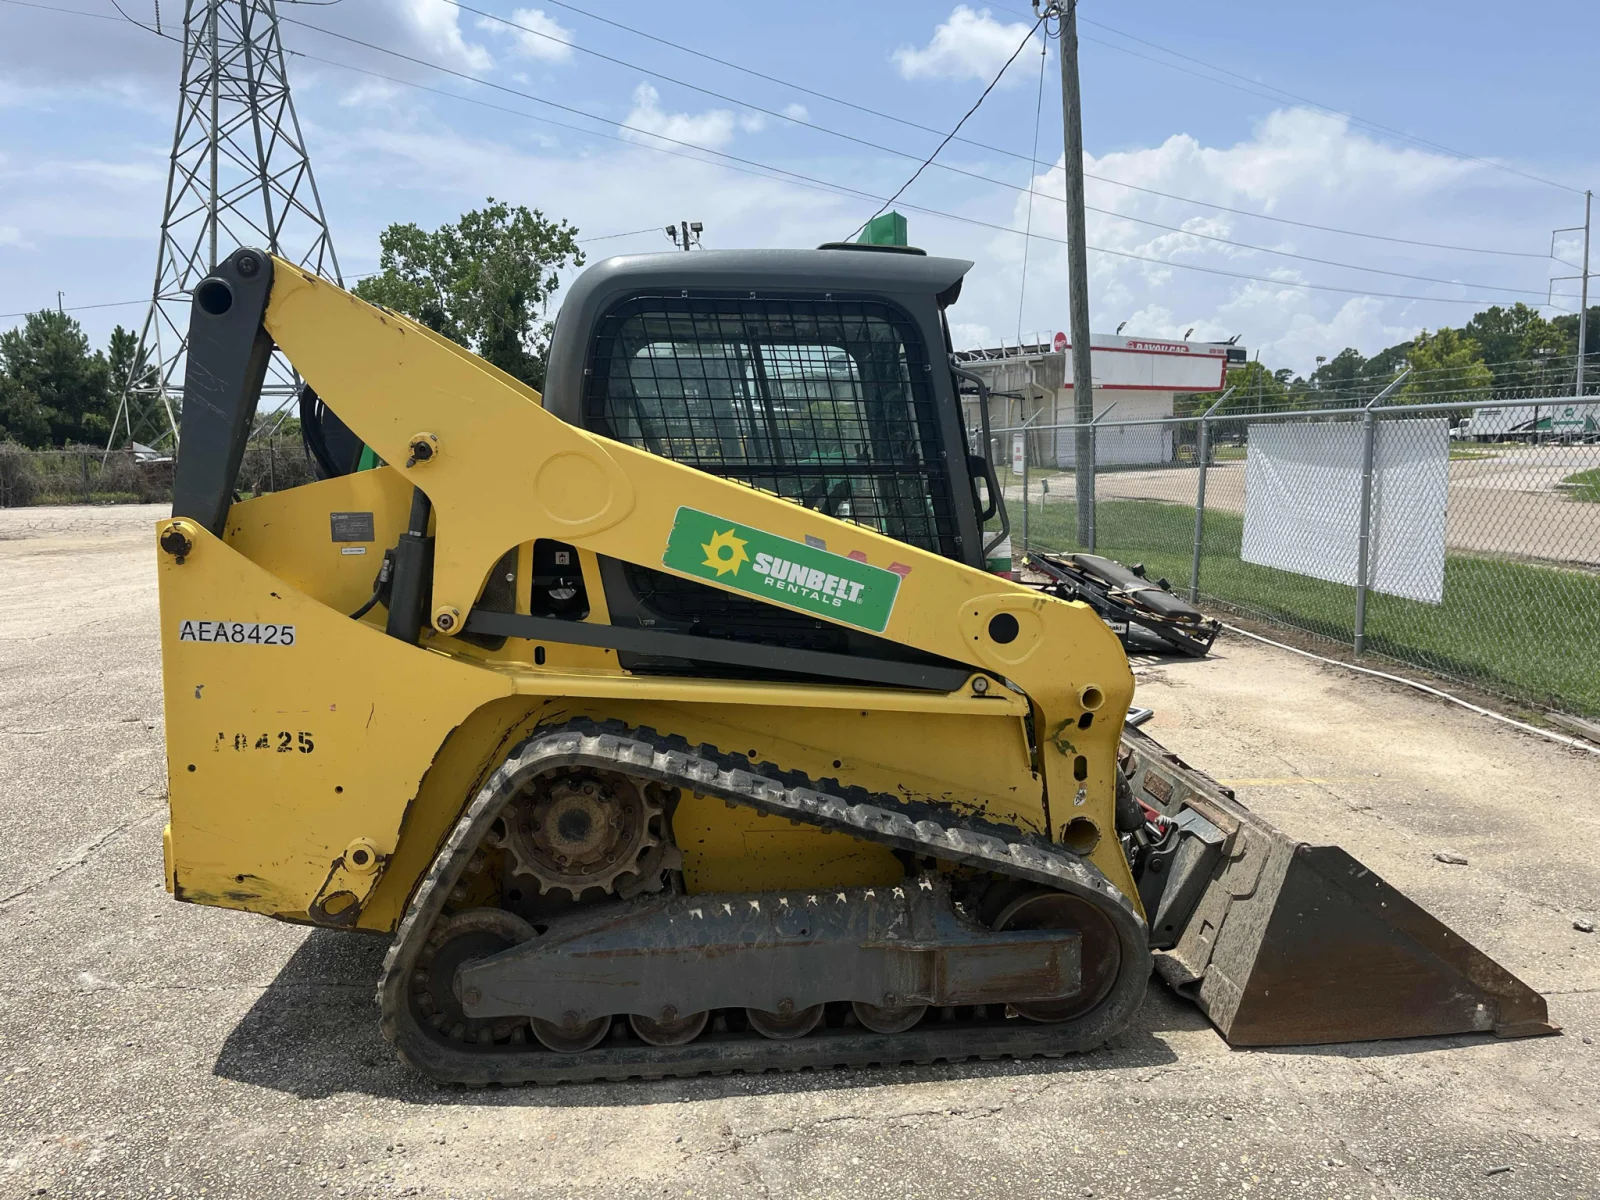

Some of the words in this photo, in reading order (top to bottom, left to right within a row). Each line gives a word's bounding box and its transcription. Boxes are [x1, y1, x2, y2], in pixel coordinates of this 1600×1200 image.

[753, 552, 865, 603] SUNBELT
[764, 578, 842, 607] RENTALS
[180, 621, 294, 645] AEA8425
